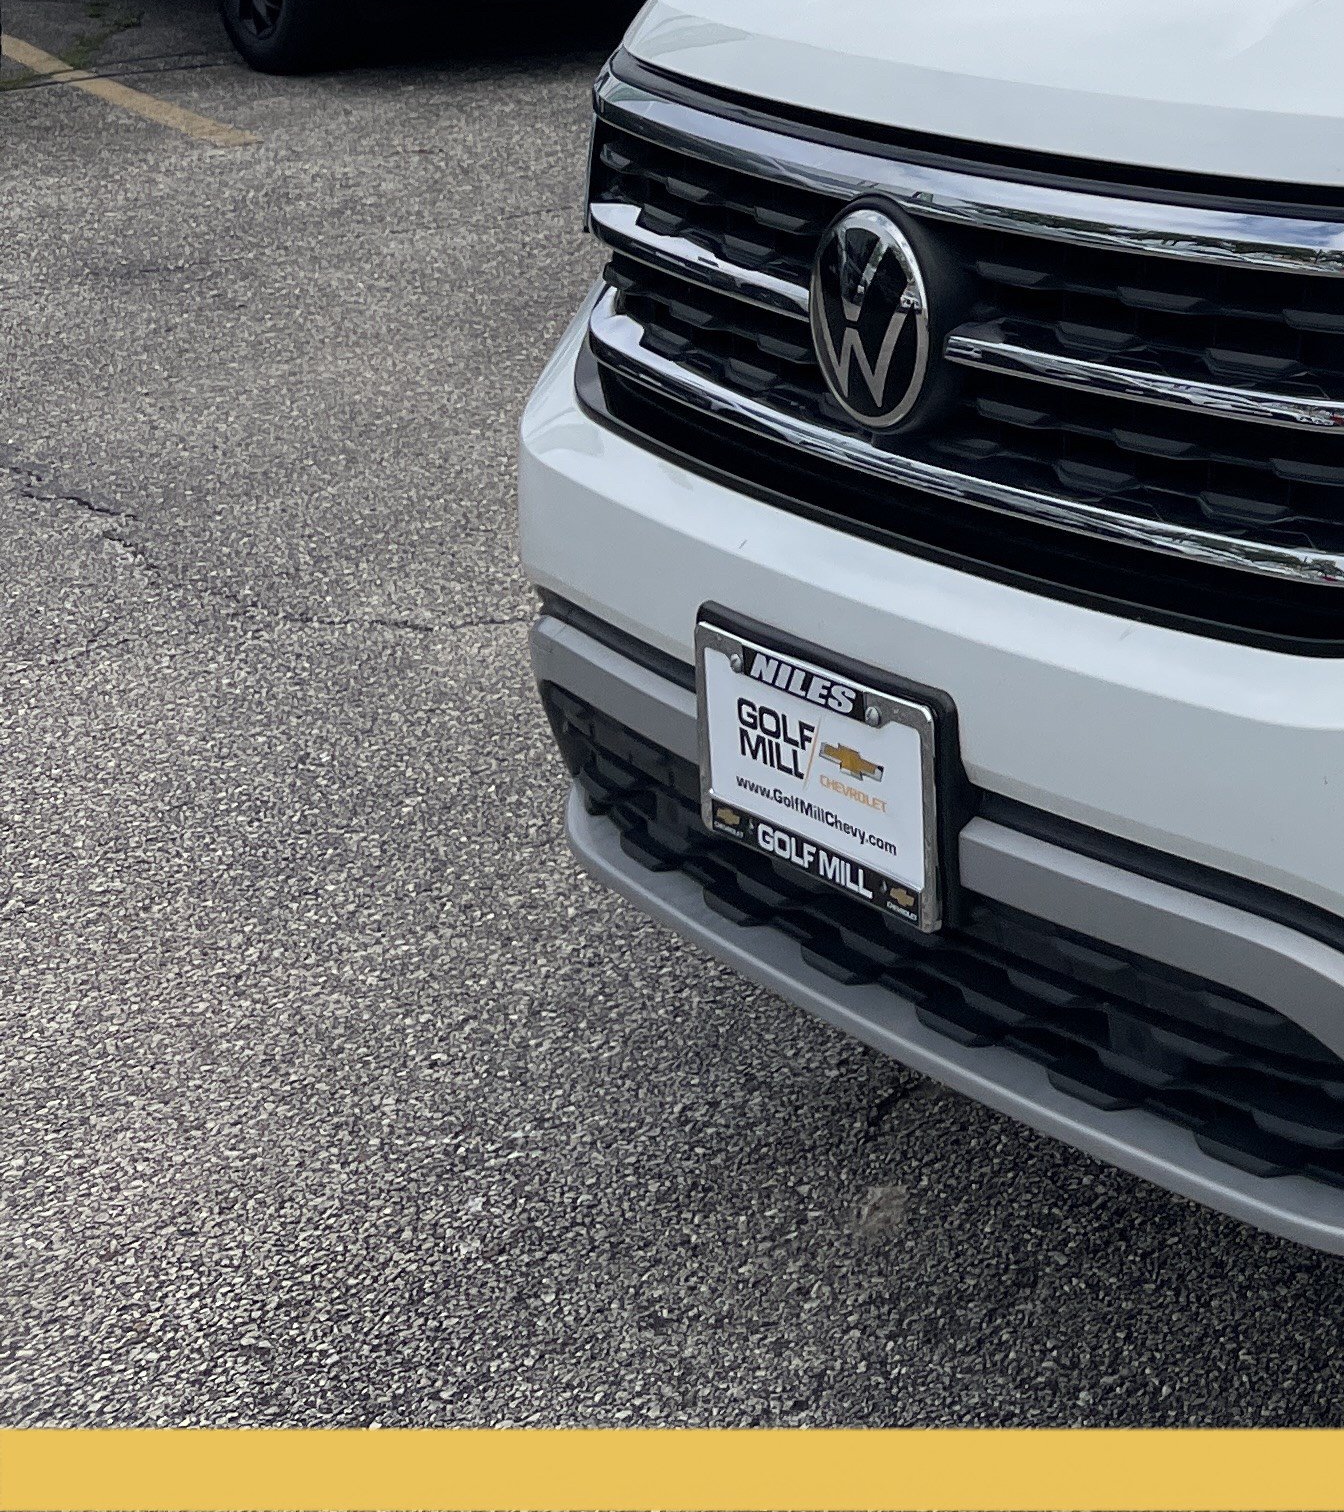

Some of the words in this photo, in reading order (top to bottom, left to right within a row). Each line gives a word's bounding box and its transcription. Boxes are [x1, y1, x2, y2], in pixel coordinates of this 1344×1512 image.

[750, 653, 857, 715] NILES
[736, 697, 816, 750] GOLF
[739, 727, 806, 781] MILL
[735, 774, 898, 857] www.GolfMillChevy.com
[819, 774, 888, 814] CHEVROLET
[757, 823, 817, 869] GOLF
[819, 849, 873, 900] MILL
